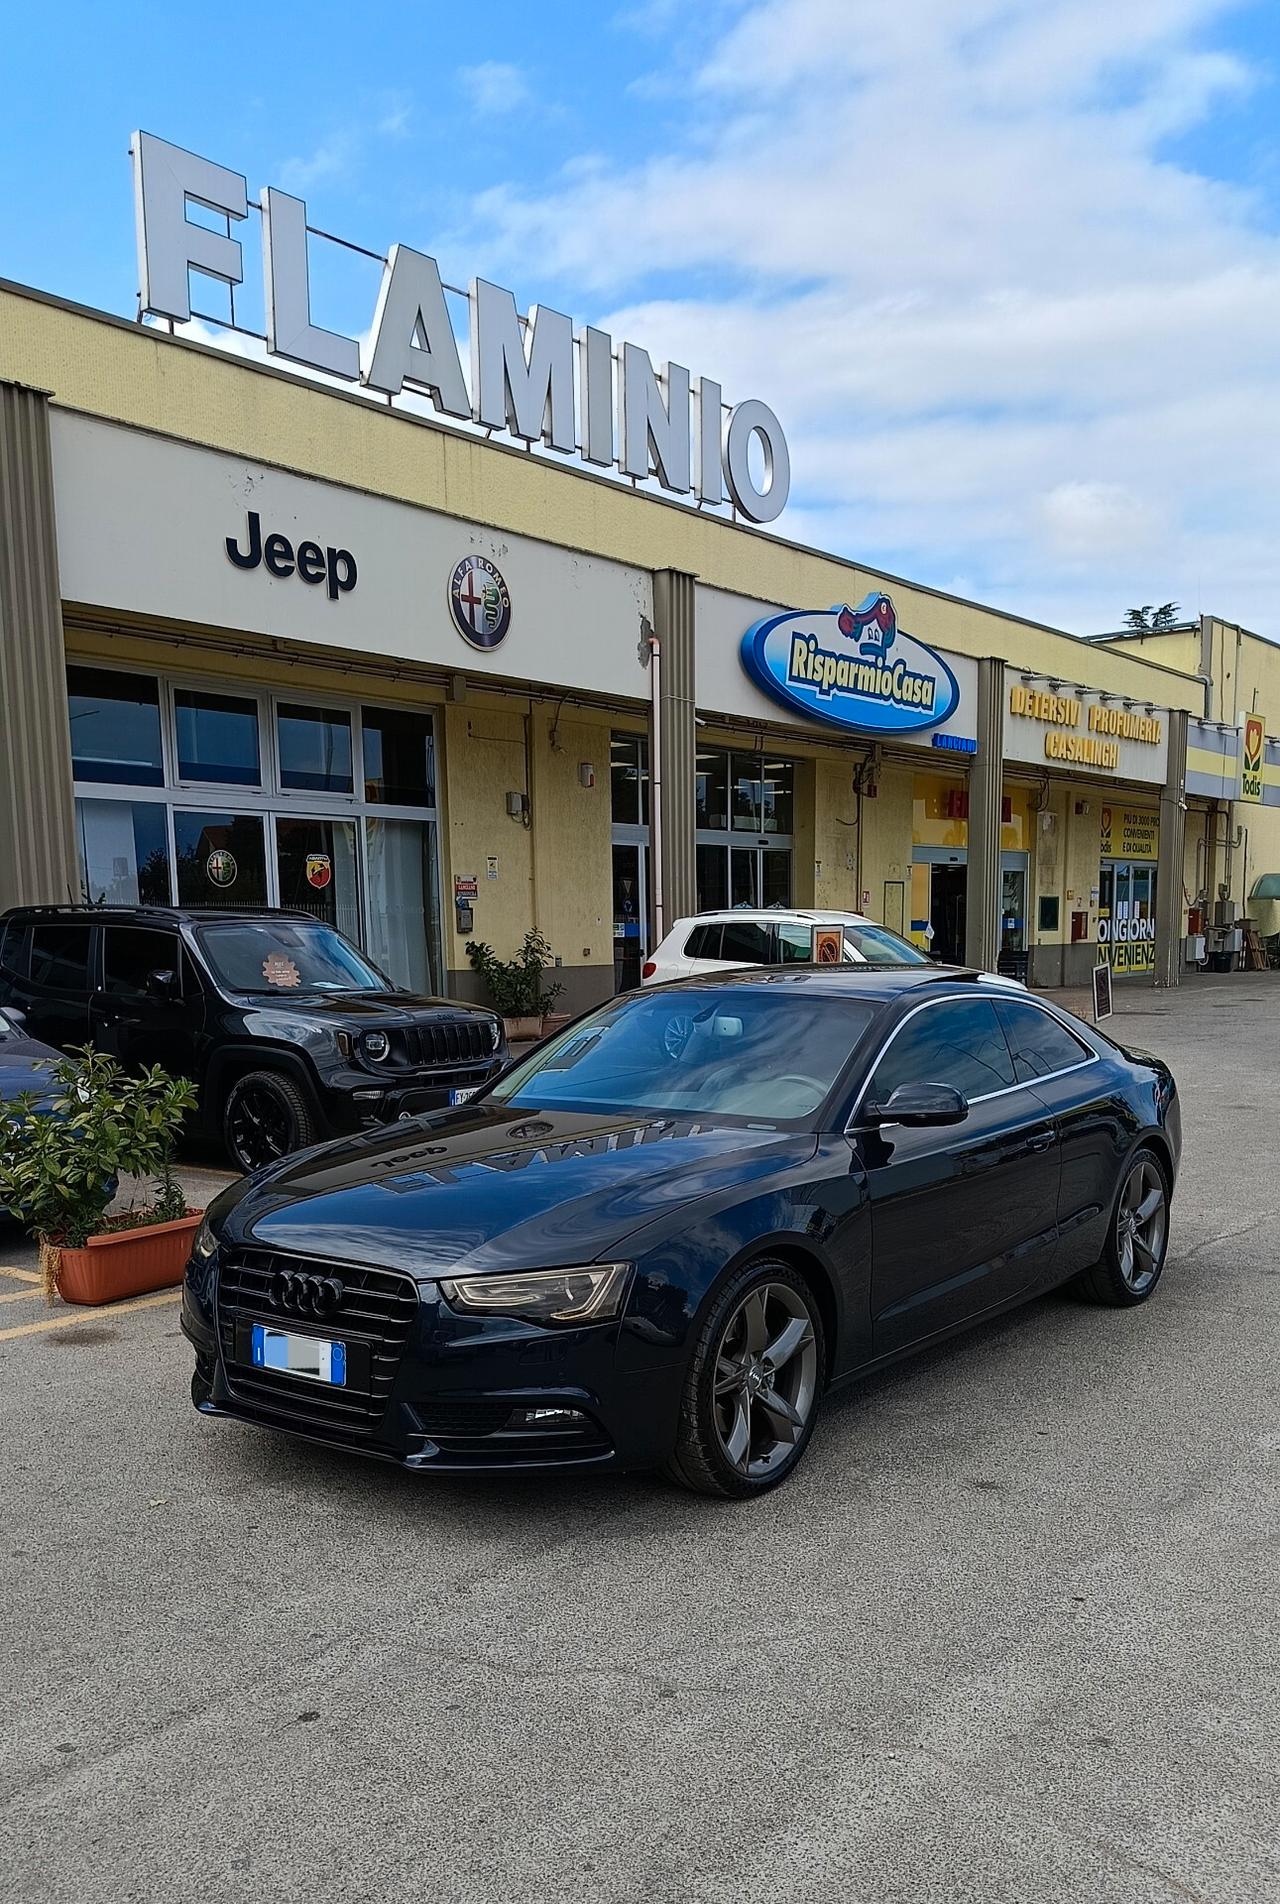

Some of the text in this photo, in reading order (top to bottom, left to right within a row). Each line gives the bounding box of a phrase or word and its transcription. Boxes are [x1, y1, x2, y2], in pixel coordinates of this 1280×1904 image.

[131, 129, 791, 524] FLAMINIO
[225, 510, 358, 601] Jeep
[452, 558, 510, 609] ALFA ROMEO
[791, 636, 934, 708] RisparmioCasa
[1010, 686, 1162, 745] DETERSIVI PROFUMERIA
[1242, 773, 1261, 797] Todis
[1100, 840, 1112, 854] odis
